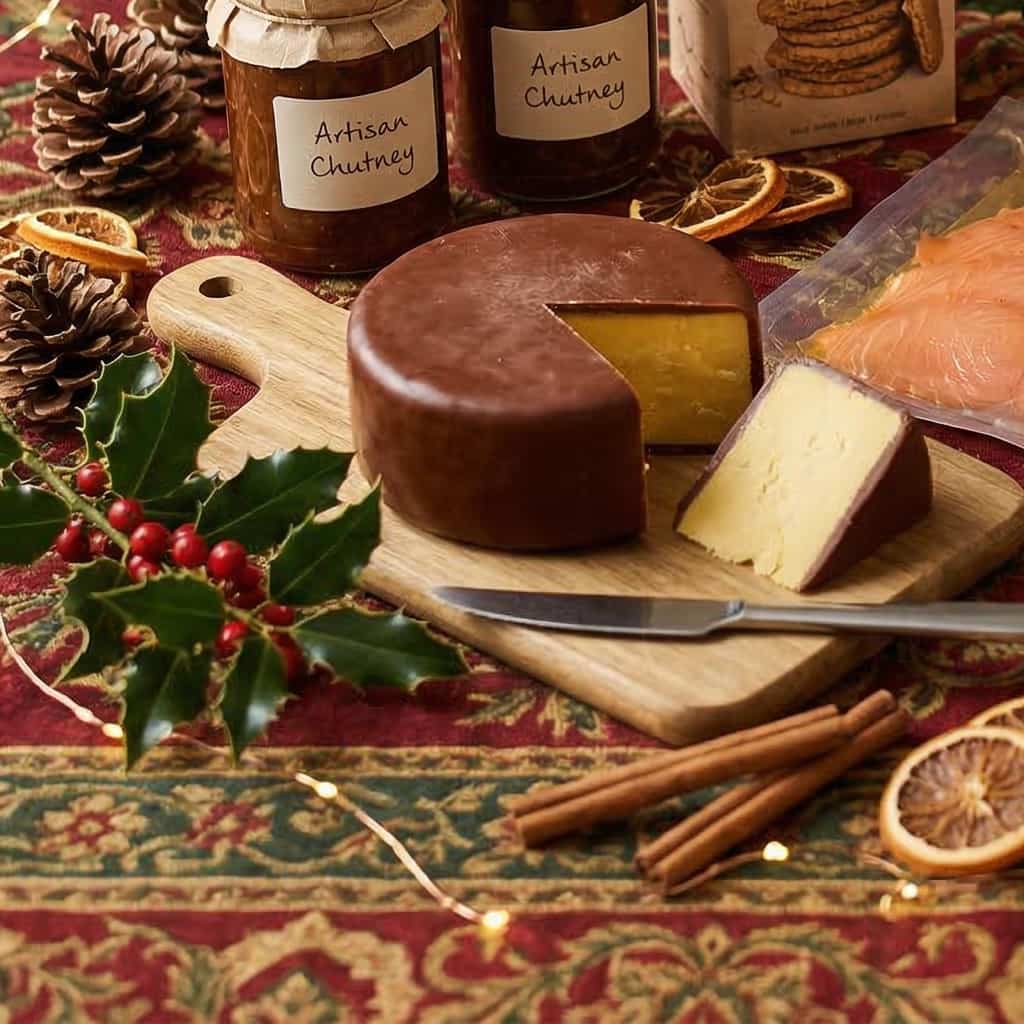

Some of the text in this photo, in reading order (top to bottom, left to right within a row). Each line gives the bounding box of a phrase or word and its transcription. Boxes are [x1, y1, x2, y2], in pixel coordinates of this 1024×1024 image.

[530, 50, 622, 77] Artisan
[524, 79, 625, 111] Chutney
[314, 115, 409, 145] Artisan
[310, 144, 415, 177] Chutney
